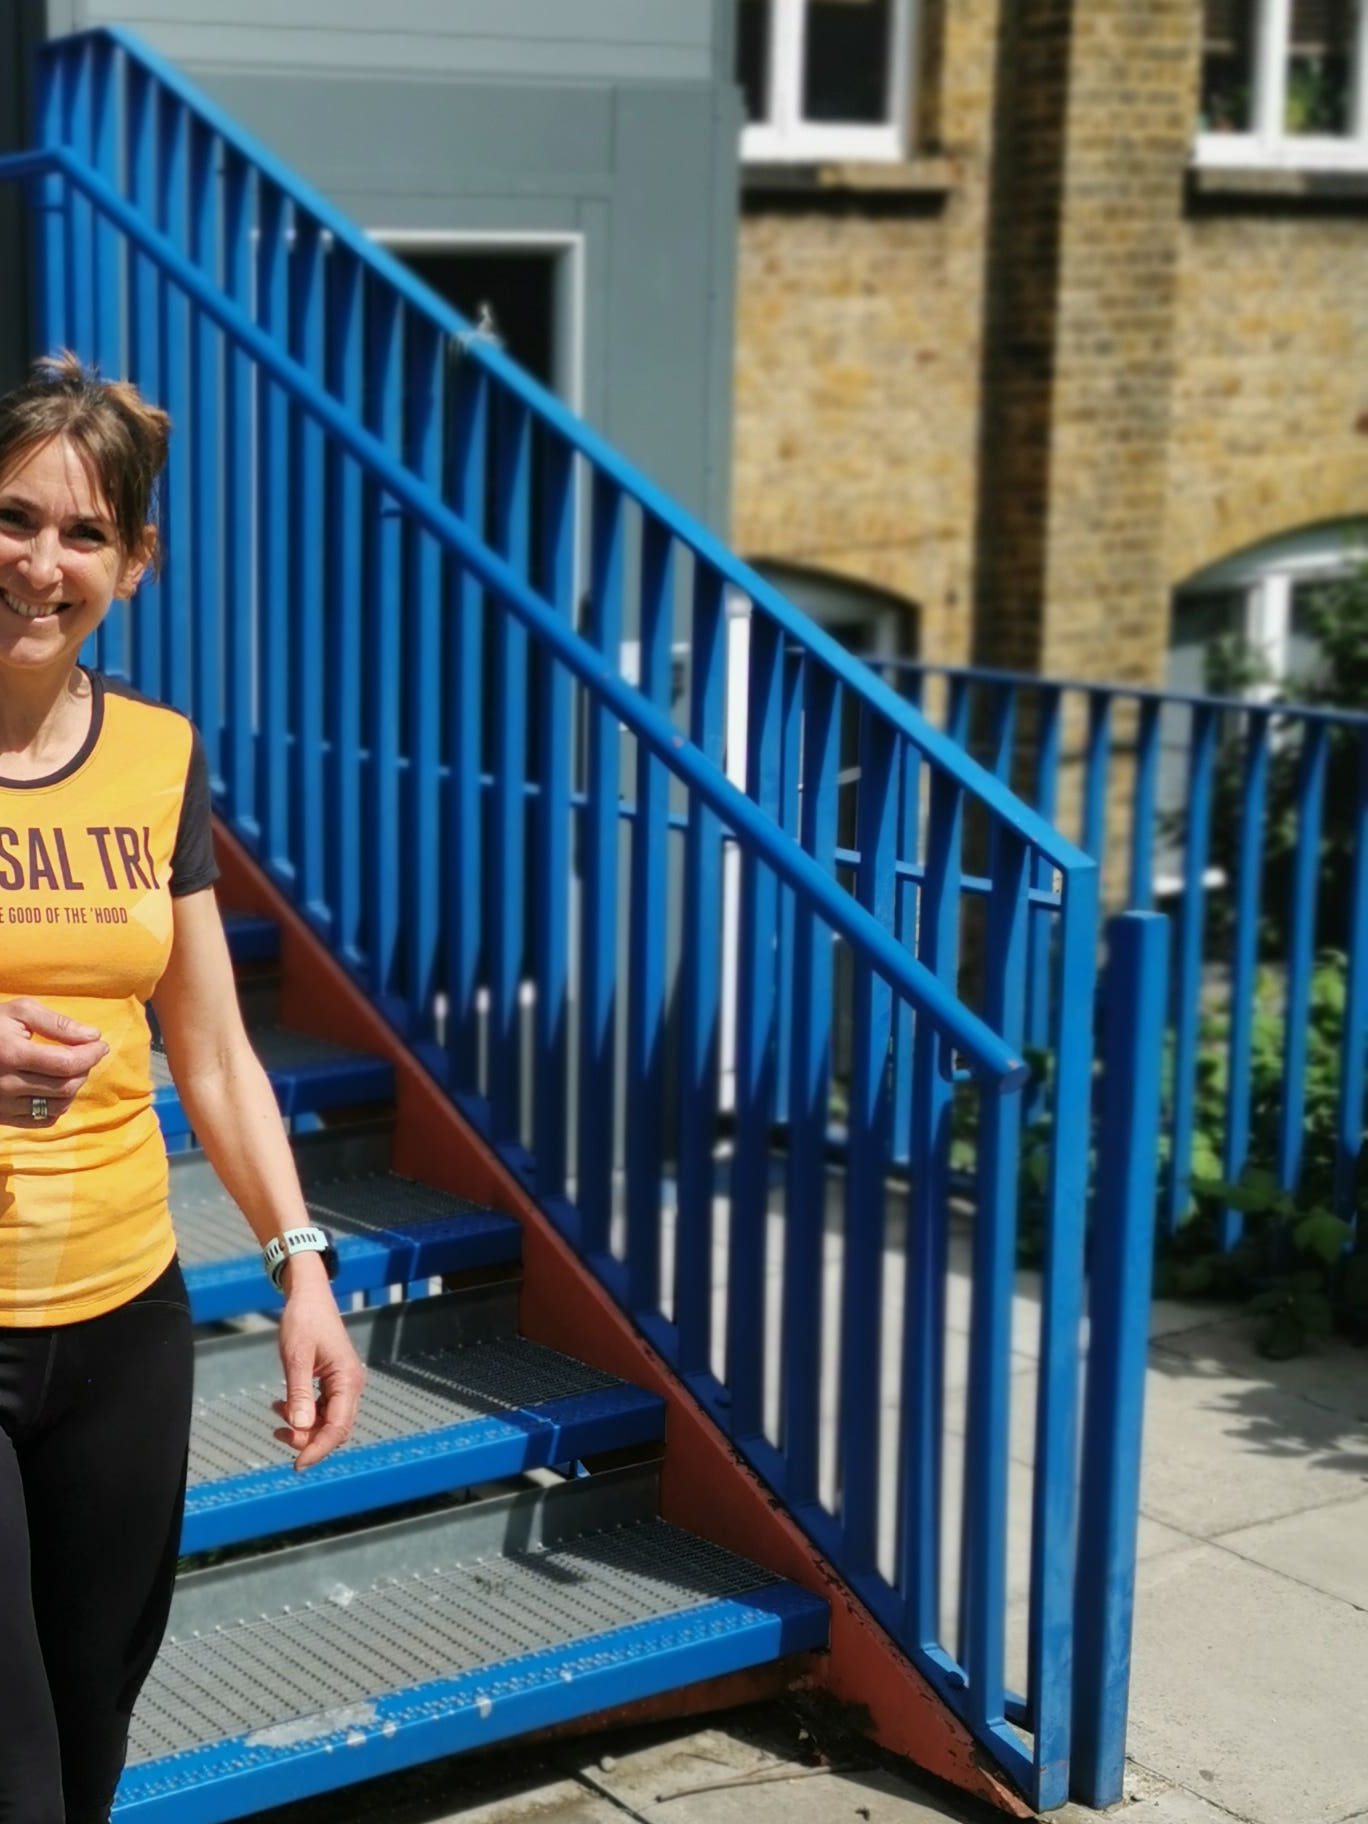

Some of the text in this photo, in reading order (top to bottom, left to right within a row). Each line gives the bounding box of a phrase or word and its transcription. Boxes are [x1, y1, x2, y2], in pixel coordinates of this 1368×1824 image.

[86, 827, 160, 890] TRI
[8, 906, 42, 924] GOOD
[45, 906, 60, 924] OF
[63, 907, 88, 924] THE
[90, 907, 128, 924] 'HOOD
